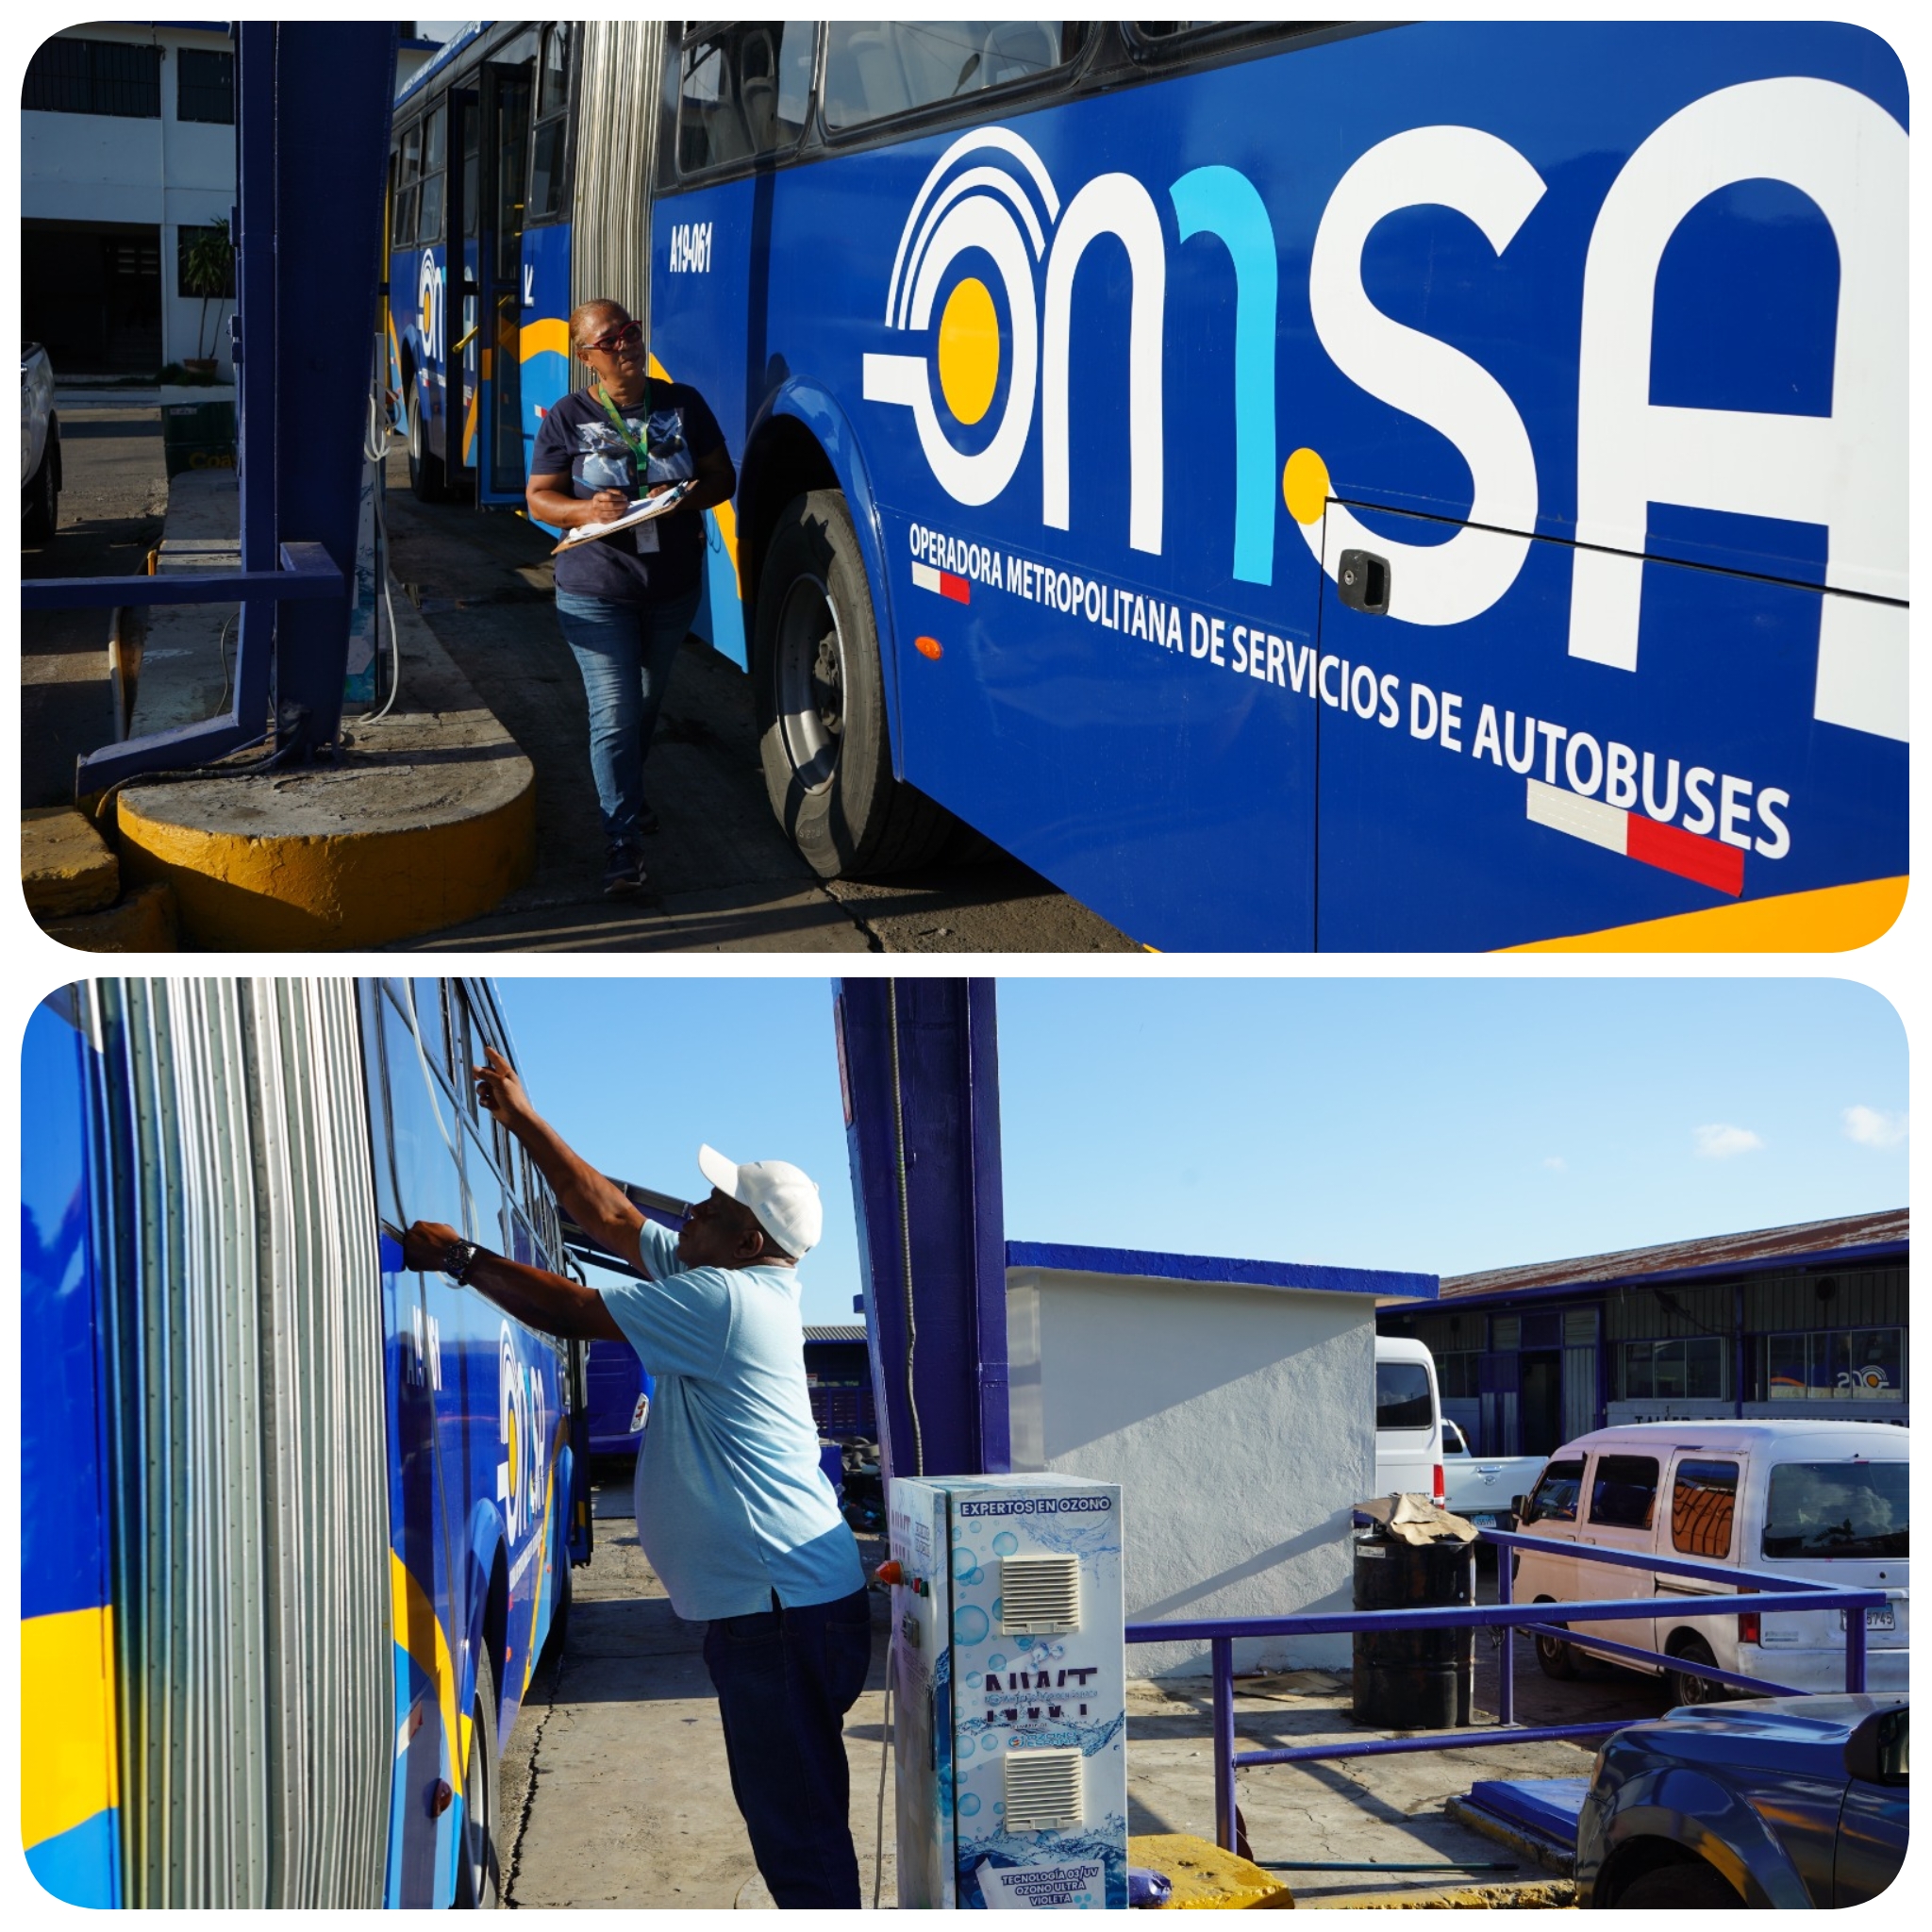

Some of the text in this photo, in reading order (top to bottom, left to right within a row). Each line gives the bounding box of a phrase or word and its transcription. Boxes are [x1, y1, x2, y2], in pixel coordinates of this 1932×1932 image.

[669, 222, 712, 274] A19-061
[909, 523, 1790, 859] OPERADORA METROPOLITANA DE SERVICIOS DE AUTOBUSES
[960, 1496, 1111, 1517] EXPERTOS EN OZONO
[1002, 1869, 1066, 1885] TECNOLOGÍA
[1015, 1880, 1086, 1895] OZONO ULTRA
[1029, 1893, 1073, 1907] VIOLETA
